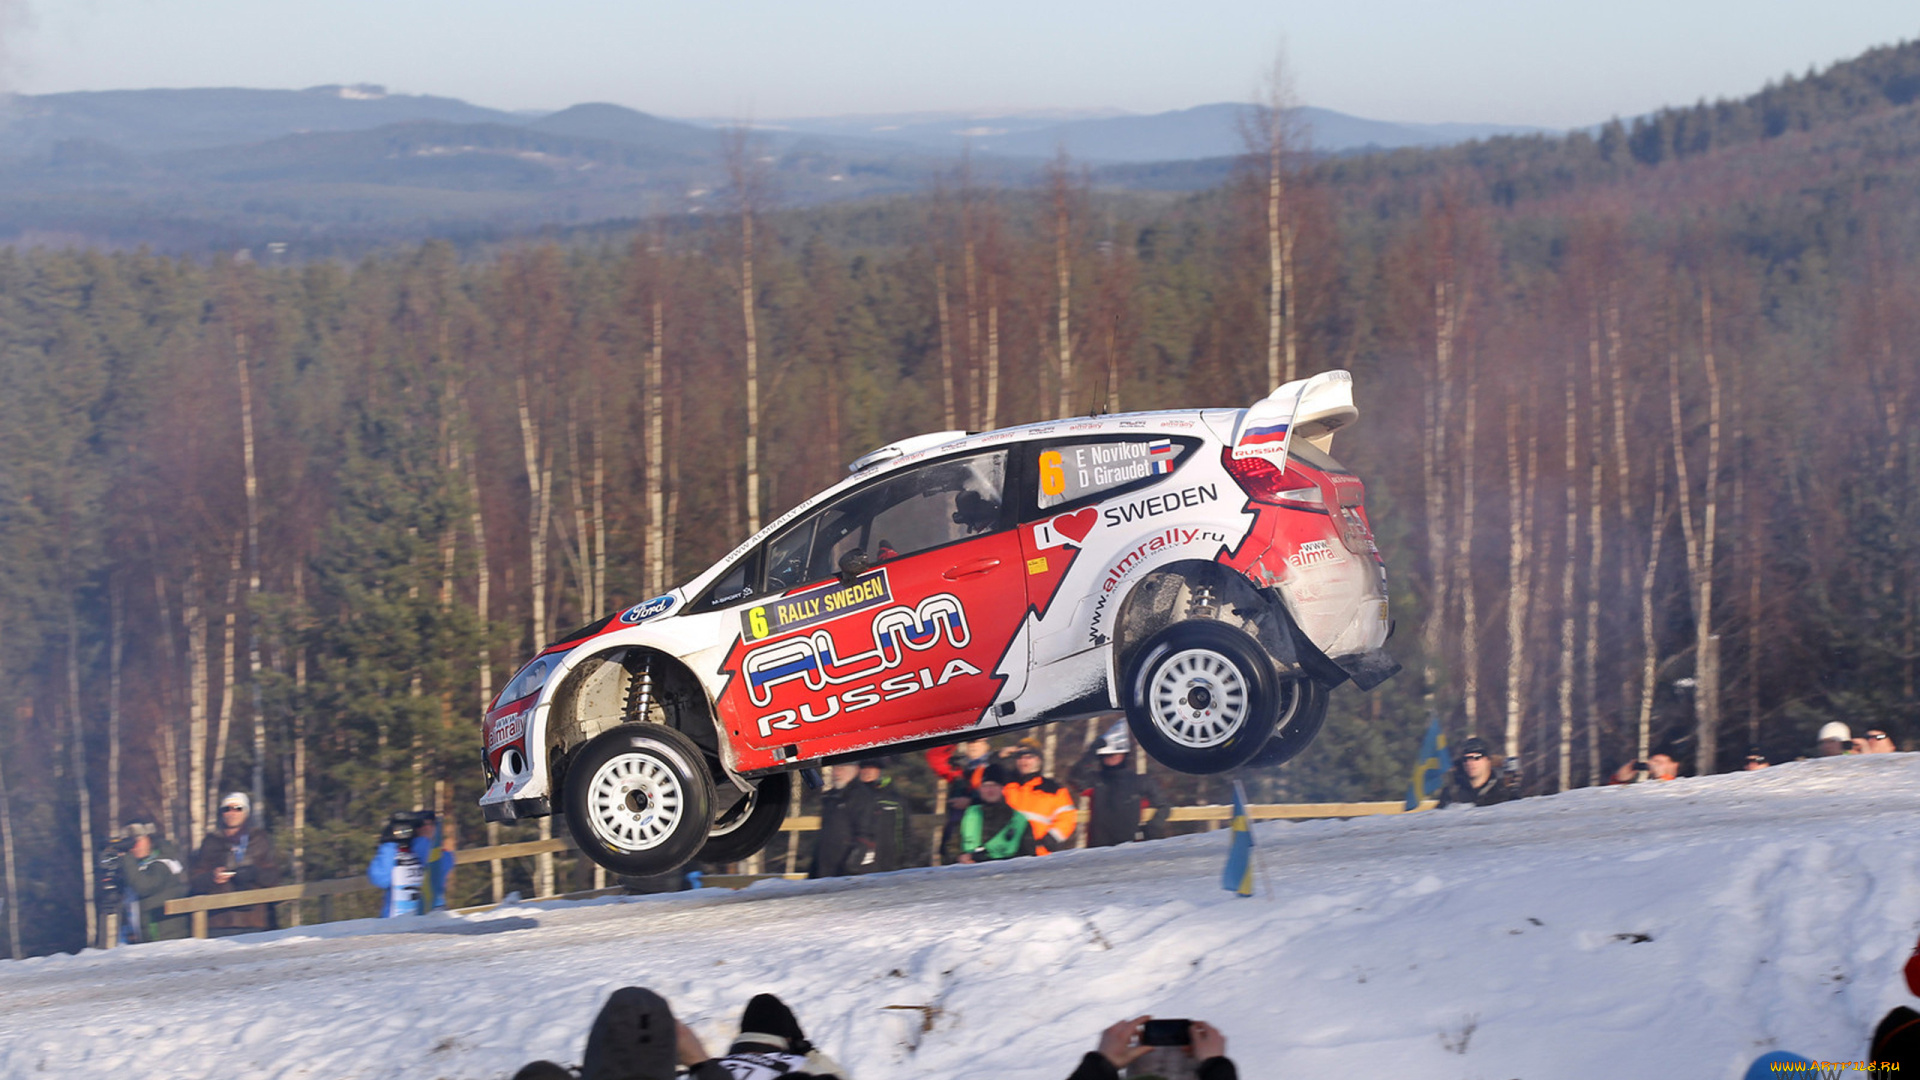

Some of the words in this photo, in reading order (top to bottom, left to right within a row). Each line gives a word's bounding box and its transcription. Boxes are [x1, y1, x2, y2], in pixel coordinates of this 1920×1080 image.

[1076, 449, 1087, 468] E
[1091, 441, 1148, 466] Novikov
[1234, 446, 1285, 457] RUSSIA
[1039, 451, 1066, 496] 6
[1079, 470, 1090, 488] D
[1094, 460, 1151, 486] Giraudet
[1104, 483, 1218, 528] SWEDEN
[1290, 549, 1340, 568] almra
[629, 599, 667, 621] Ford
[748, 606, 770, 640] 6
[777, 597, 820, 626] RALLY
[824, 576, 884, 612] SWEDEN
[742, 592, 972, 708] ALM
[756, 658, 983, 738] RUSSIA
